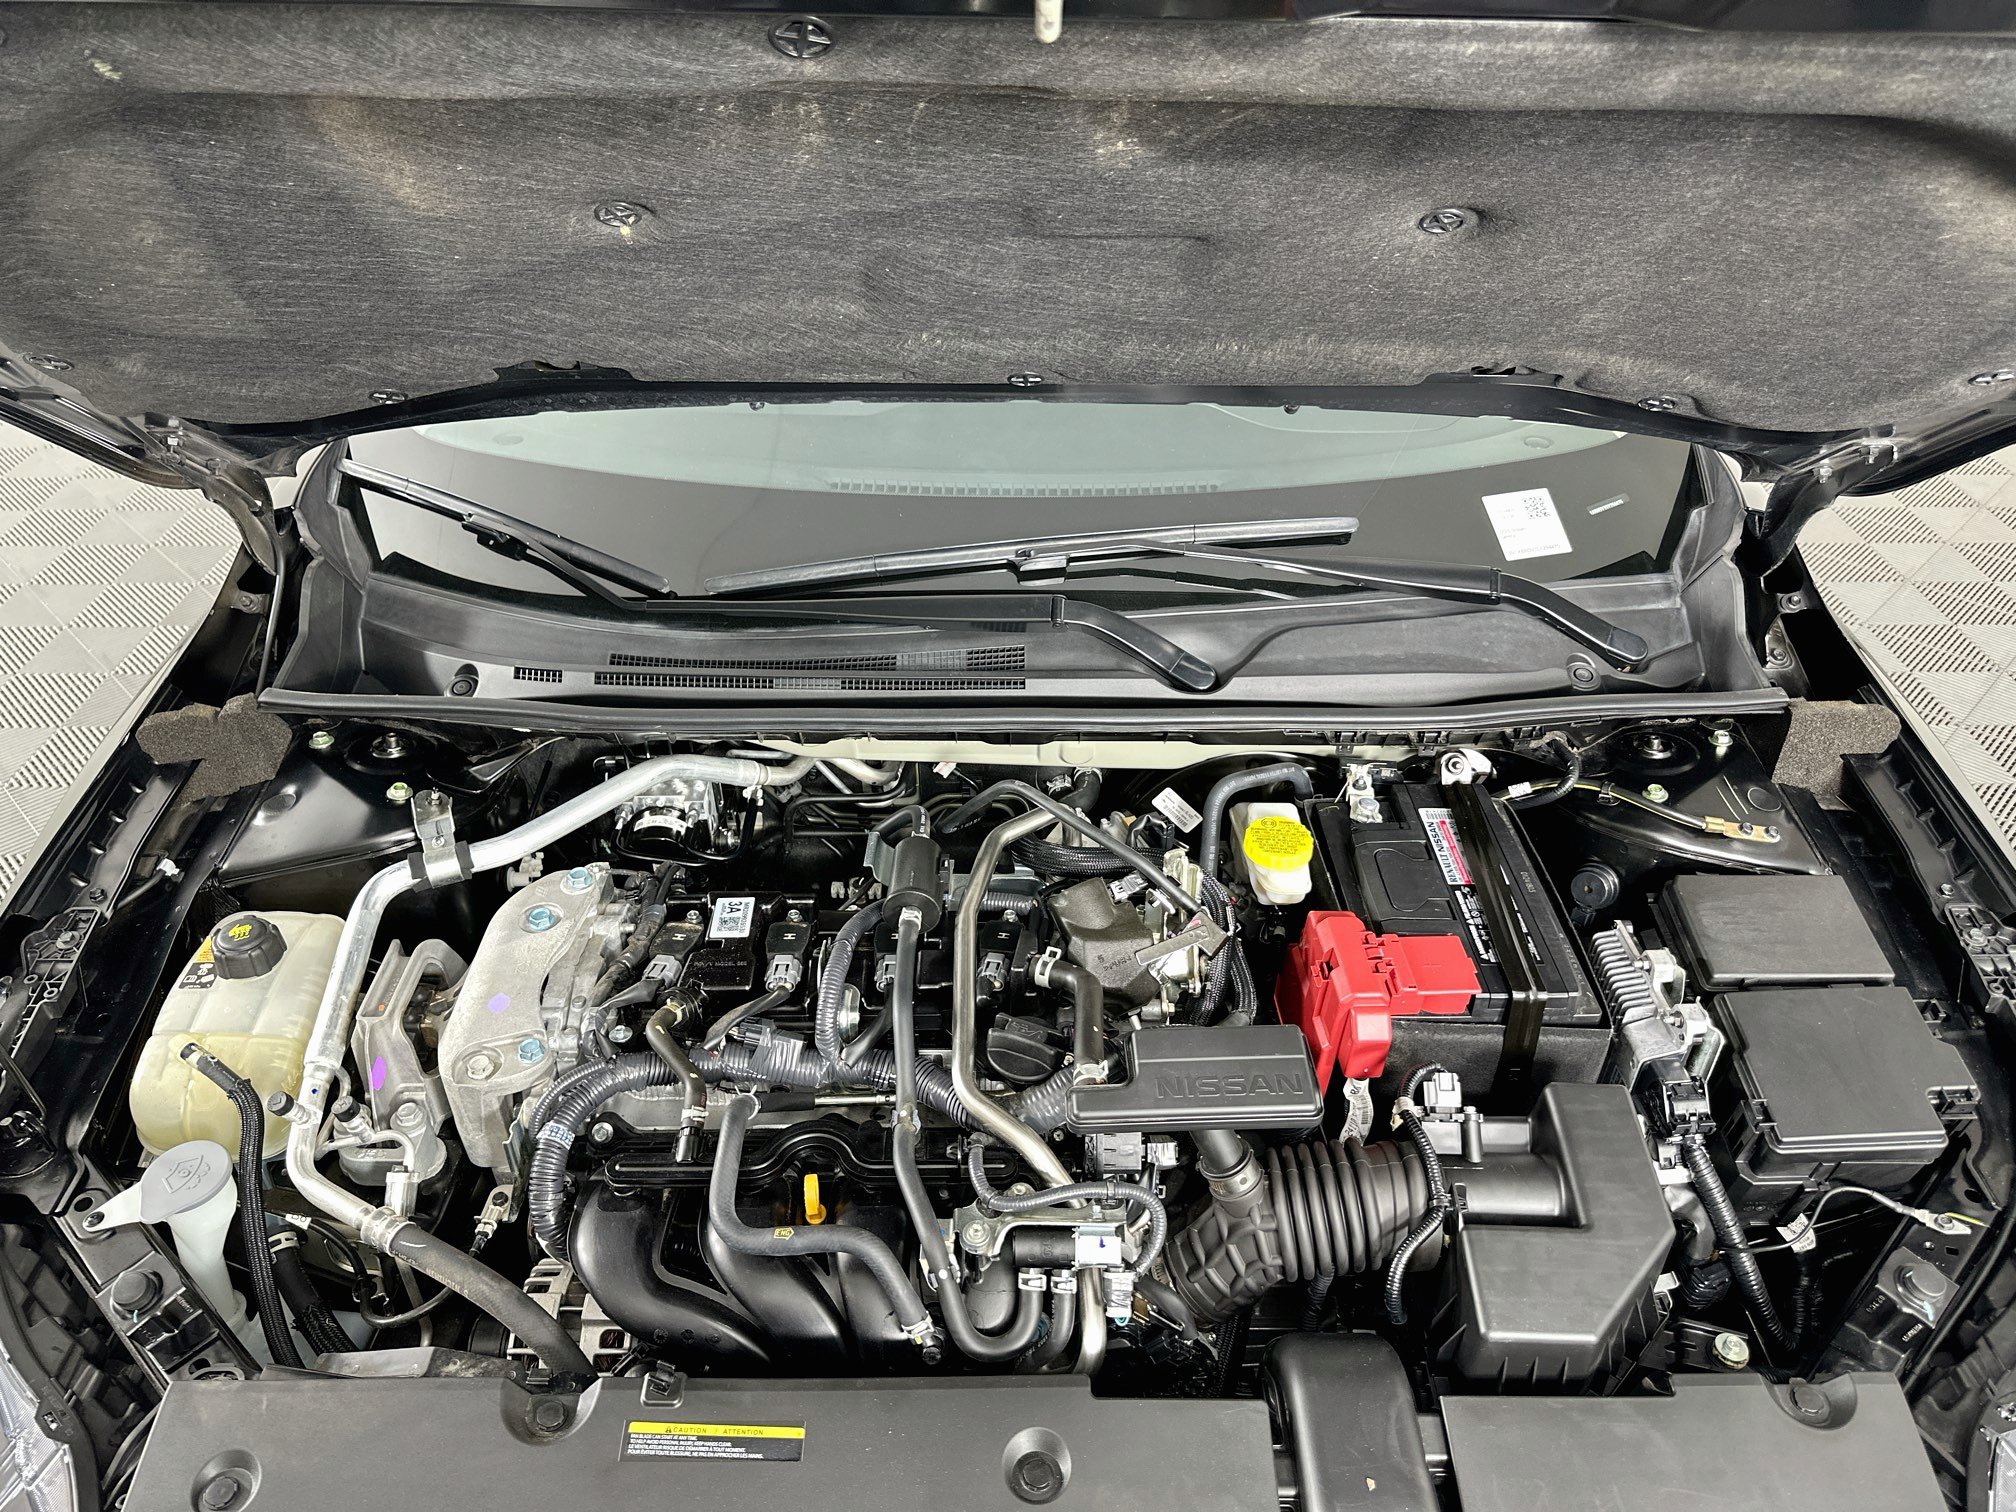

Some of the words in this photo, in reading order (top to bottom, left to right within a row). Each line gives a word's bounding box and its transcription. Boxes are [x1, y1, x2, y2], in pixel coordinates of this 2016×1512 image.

[1426, 821, 1446, 852] NISSAN
[727, 901, 742, 914] 3A
[1153, 1073, 1304, 1099] NISSAN
